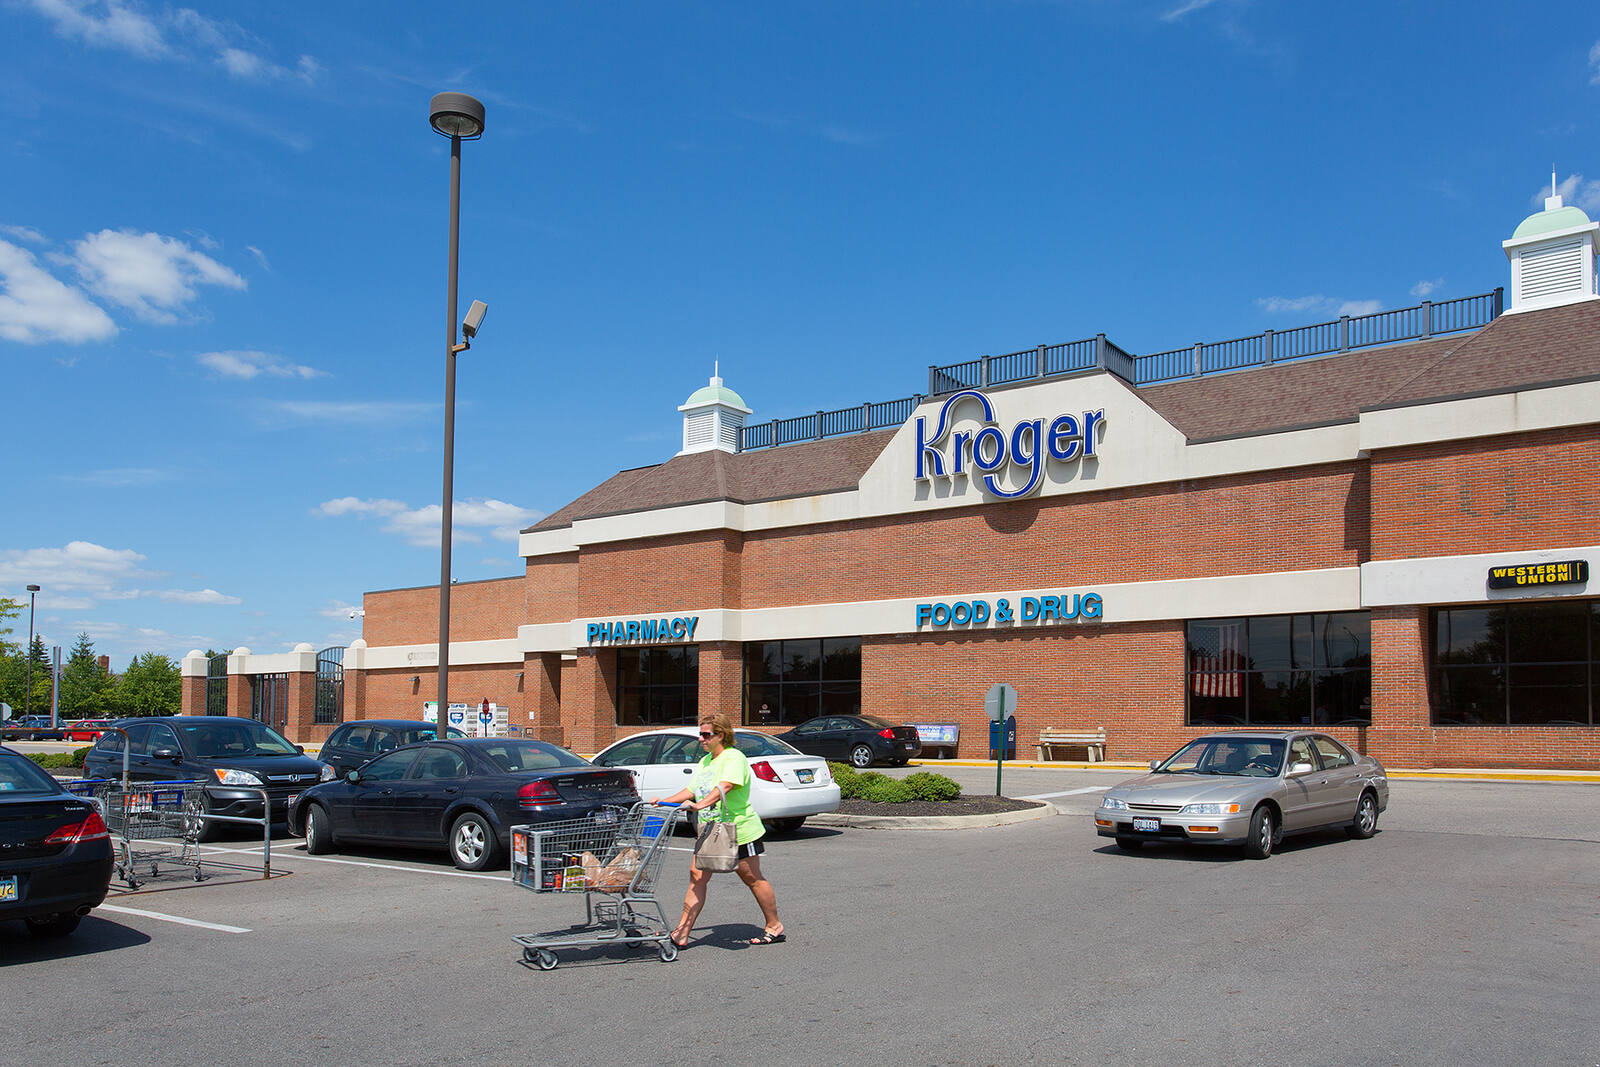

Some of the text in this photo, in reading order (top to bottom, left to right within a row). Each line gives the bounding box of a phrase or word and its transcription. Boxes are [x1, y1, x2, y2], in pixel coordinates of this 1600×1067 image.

[914, 390, 1105, 498] Kroger
[1493, 564, 1568, 578] WESTERN
[1516, 573, 1568, 585] UNION
[916, 592, 1102, 627] FOOD & DRUG
[586, 616, 698, 643] PHARMACY
